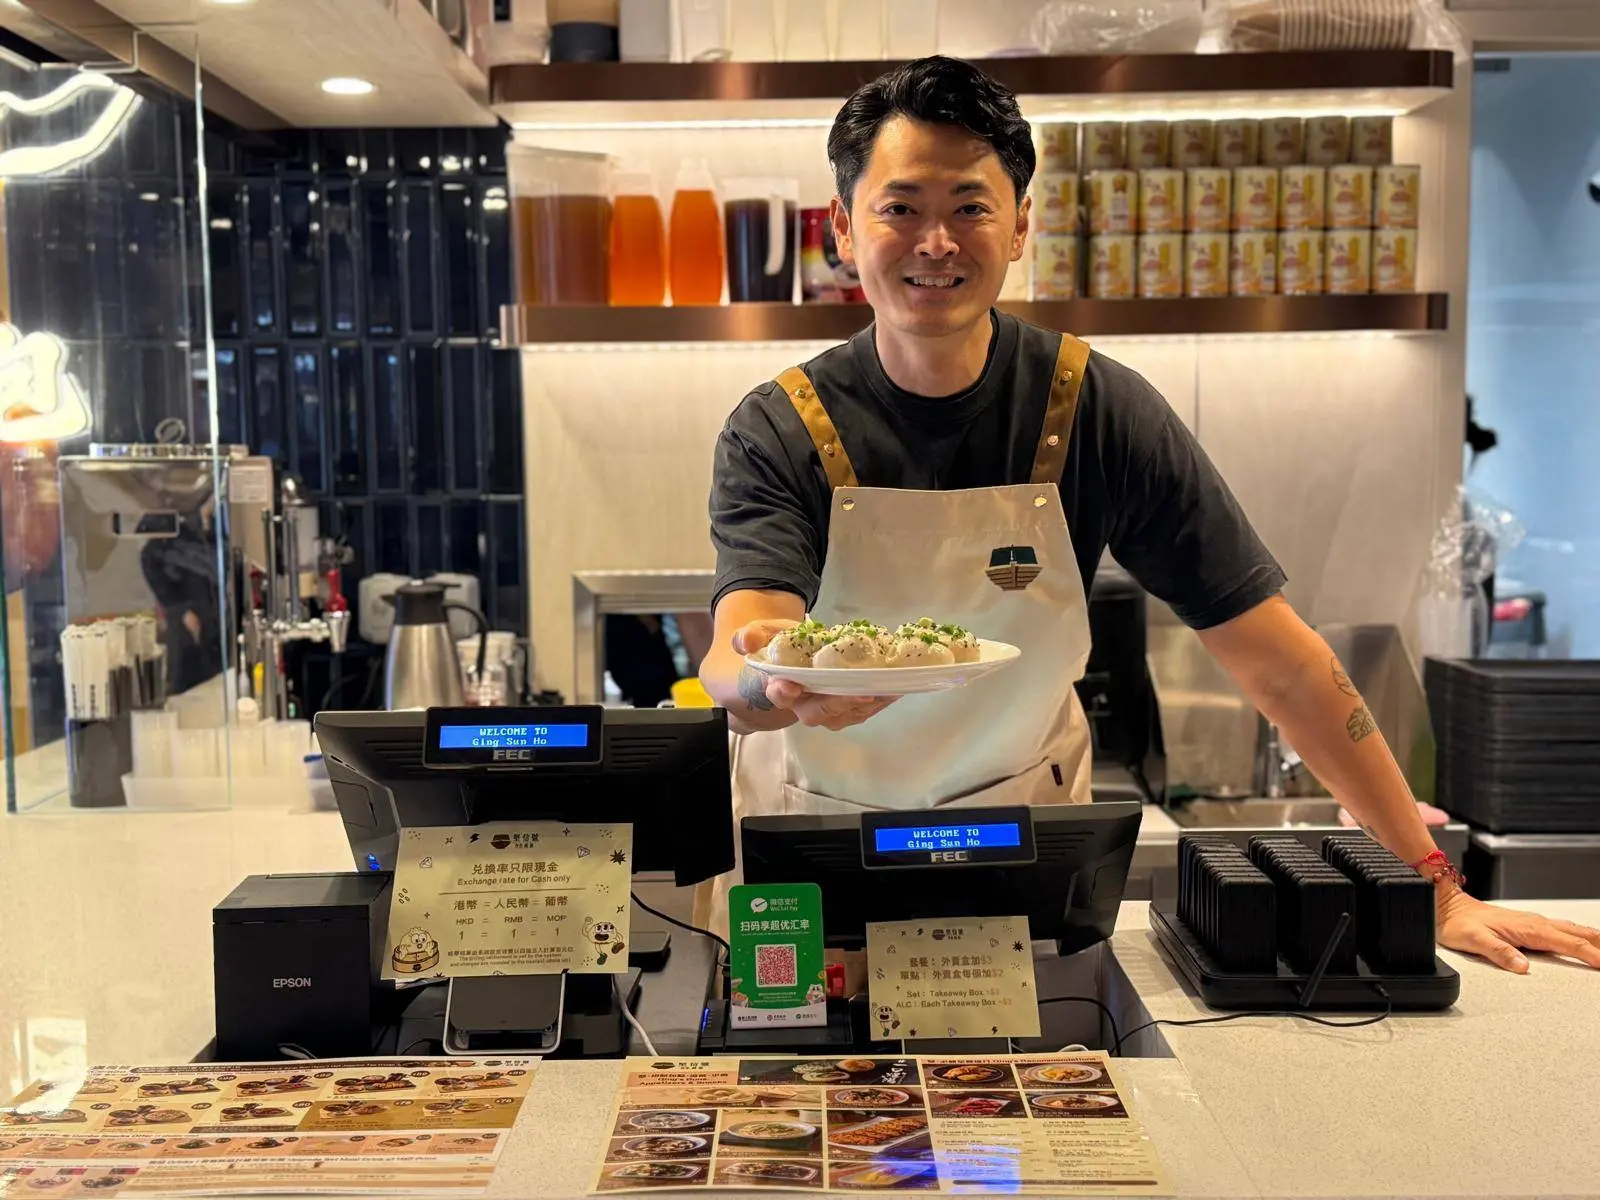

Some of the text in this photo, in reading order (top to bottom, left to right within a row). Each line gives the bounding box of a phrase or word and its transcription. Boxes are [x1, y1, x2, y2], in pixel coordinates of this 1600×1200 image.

[479, 727, 548, 736] WELCOME TO
[472, 737, 547, 747] Ging Sun Ho
[493, 749, 531, 760] FEC
[913, 828, 979, 838] WELCOME TO
[907, 838, 980, 849] Ging Sun Ho
[930, 850, 968, 862] FEC
[458, 874, 571, 886] Exchange rate for Cash only
[454, 900, 478, 911] 港幣
[494, 898, 529, 909] 人民幣
[545, 896, 568, 907] 葡幣
[455, 917, 474, 925] HKD
[546, 914, 567, 922] MOP
[740, 919, 810, 931] 扫码享超优汇率
[459, 931, 464, 940] 1
[511, 929, 516, 938] 1
[555, 927, 559, 936] 1
[273, 977, 312, 988] EPSON
[930, 990, 967, 998] Takeaway
[969, 989, 984, 997] Box
[921, 1000, 941, 1008] Each
[943, 1000, 980, 1008] Takeaway
